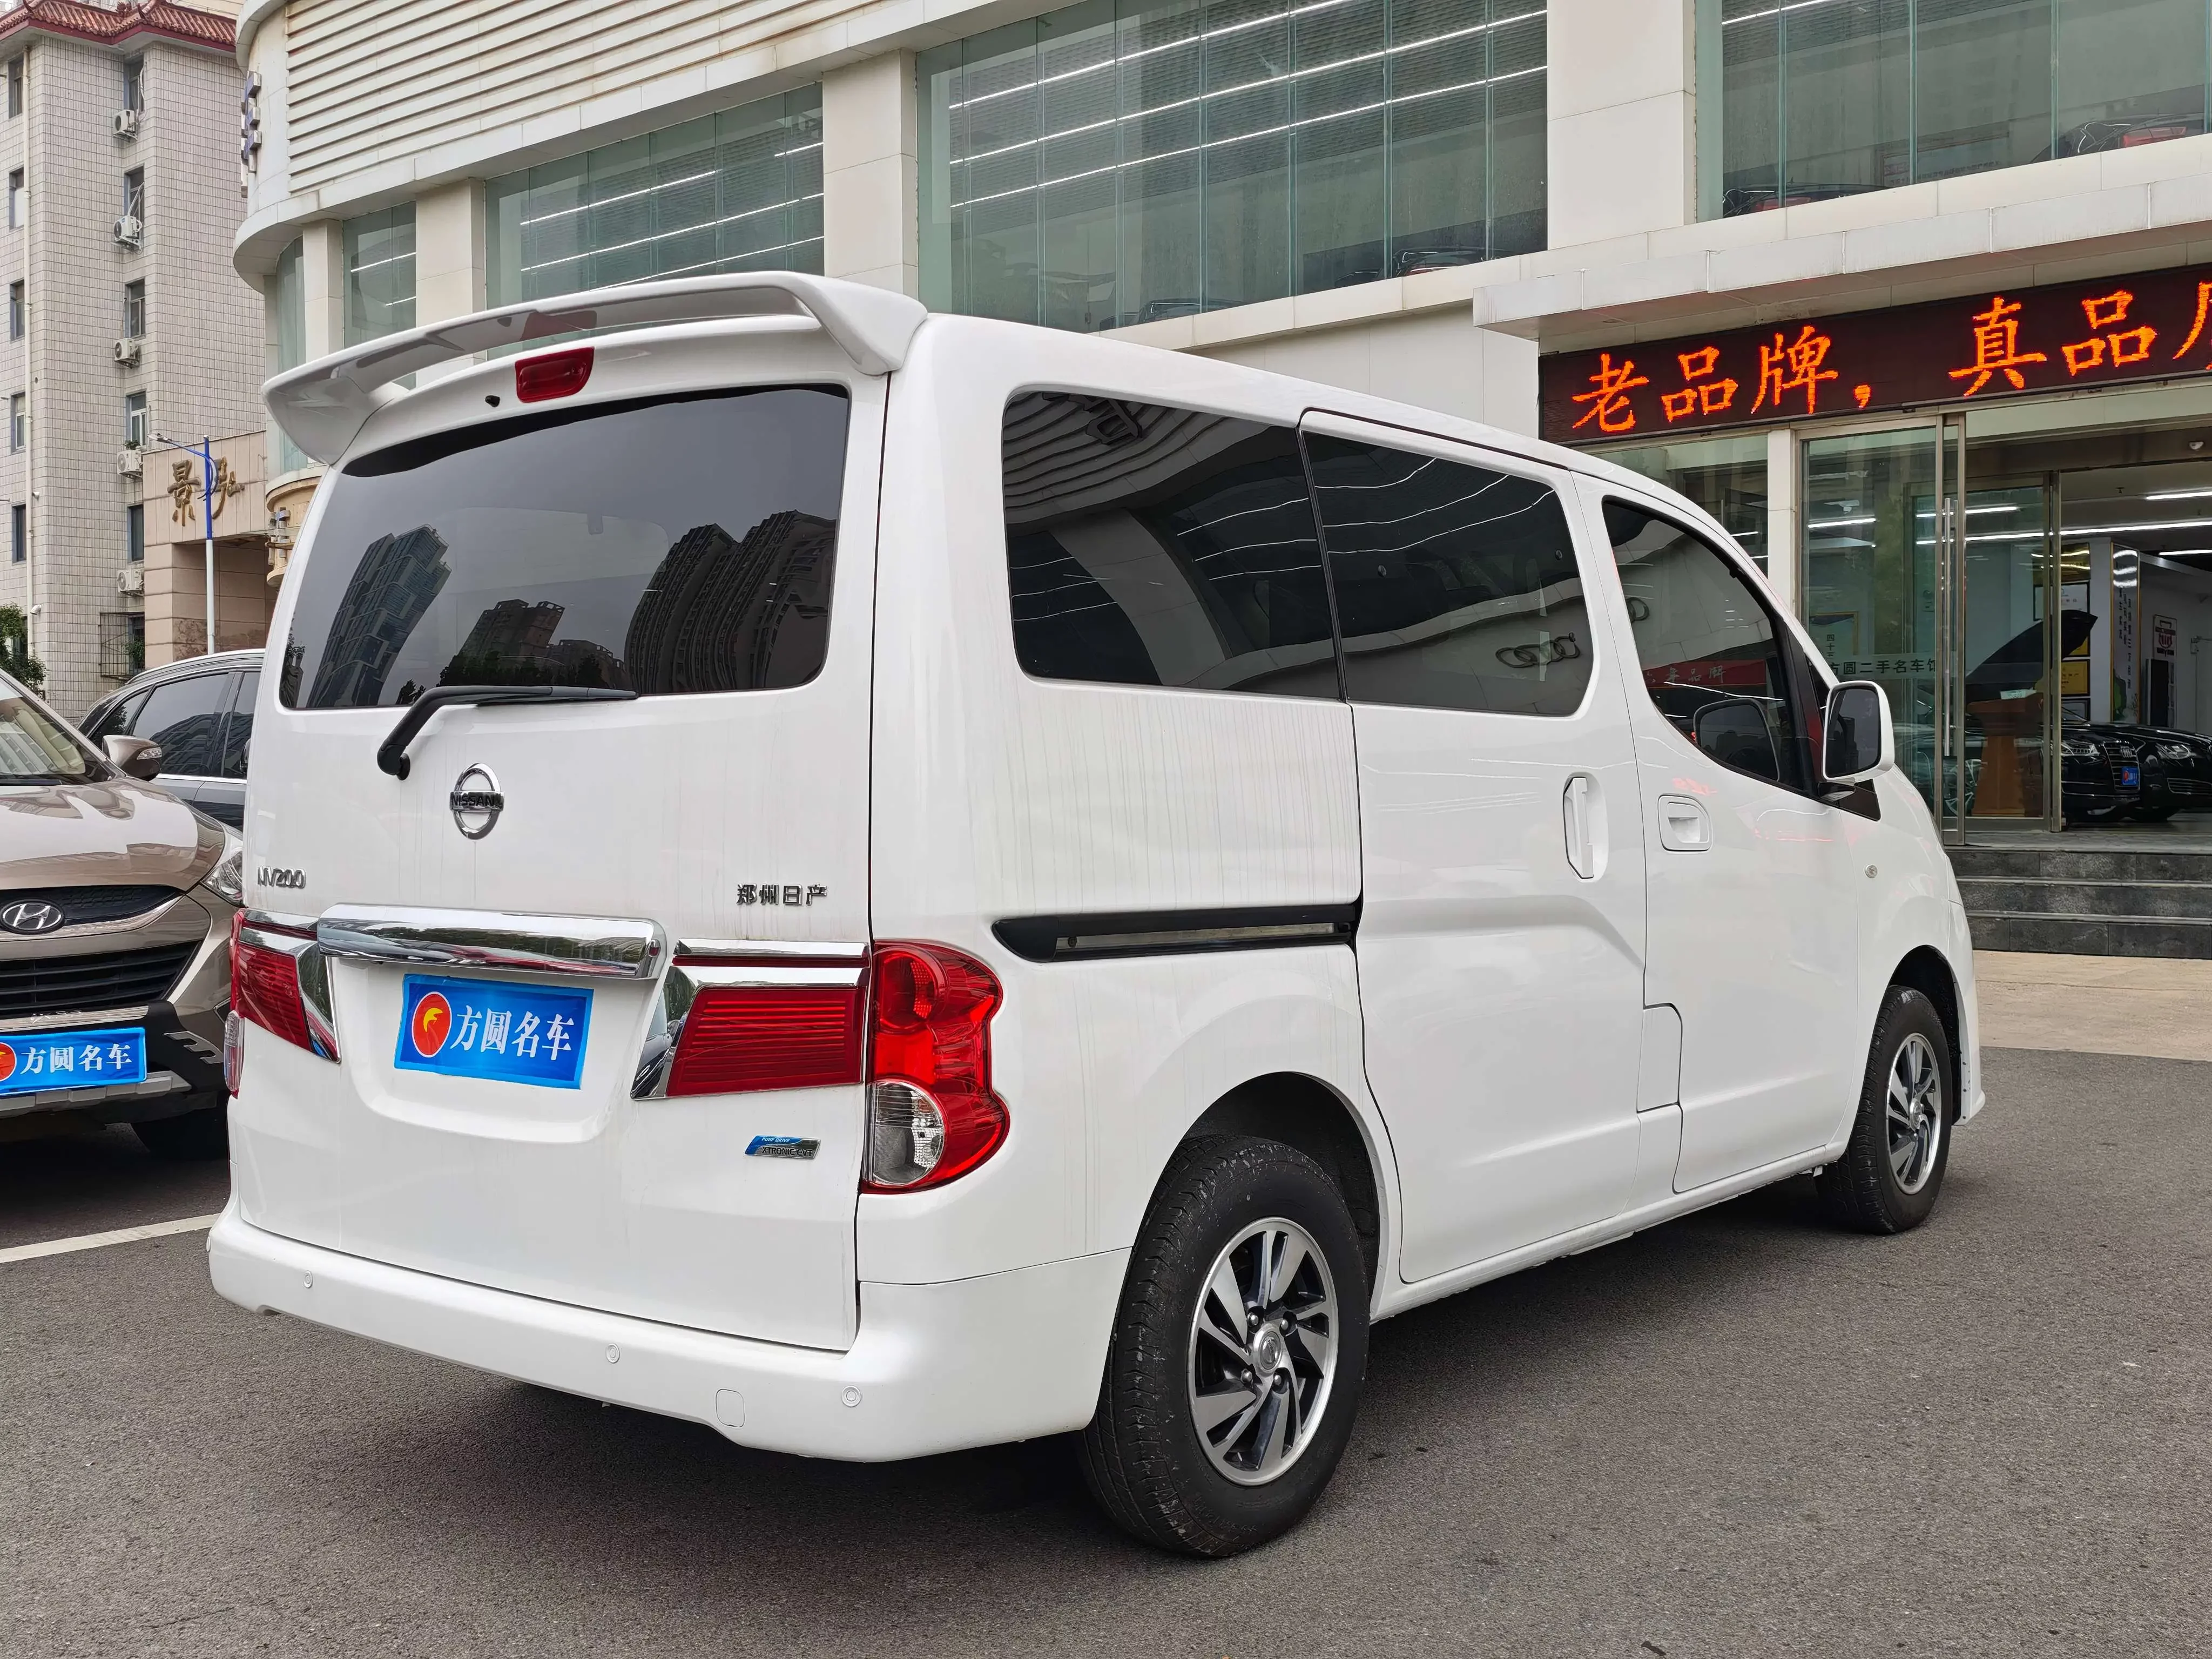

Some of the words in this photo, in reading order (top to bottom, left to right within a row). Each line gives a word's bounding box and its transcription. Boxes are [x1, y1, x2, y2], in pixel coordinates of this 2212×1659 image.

[450, 791, 495, 807] NISSAN
[257, 866, 306, 889] NV200
[736, 884, 827, 906] 郑州日产
[450, 1004, 574, 1060] 方圆名车
[20, 1043, 132, 1075] 方圆名车
[761, 1147, 795, 1156] XTRONIC
